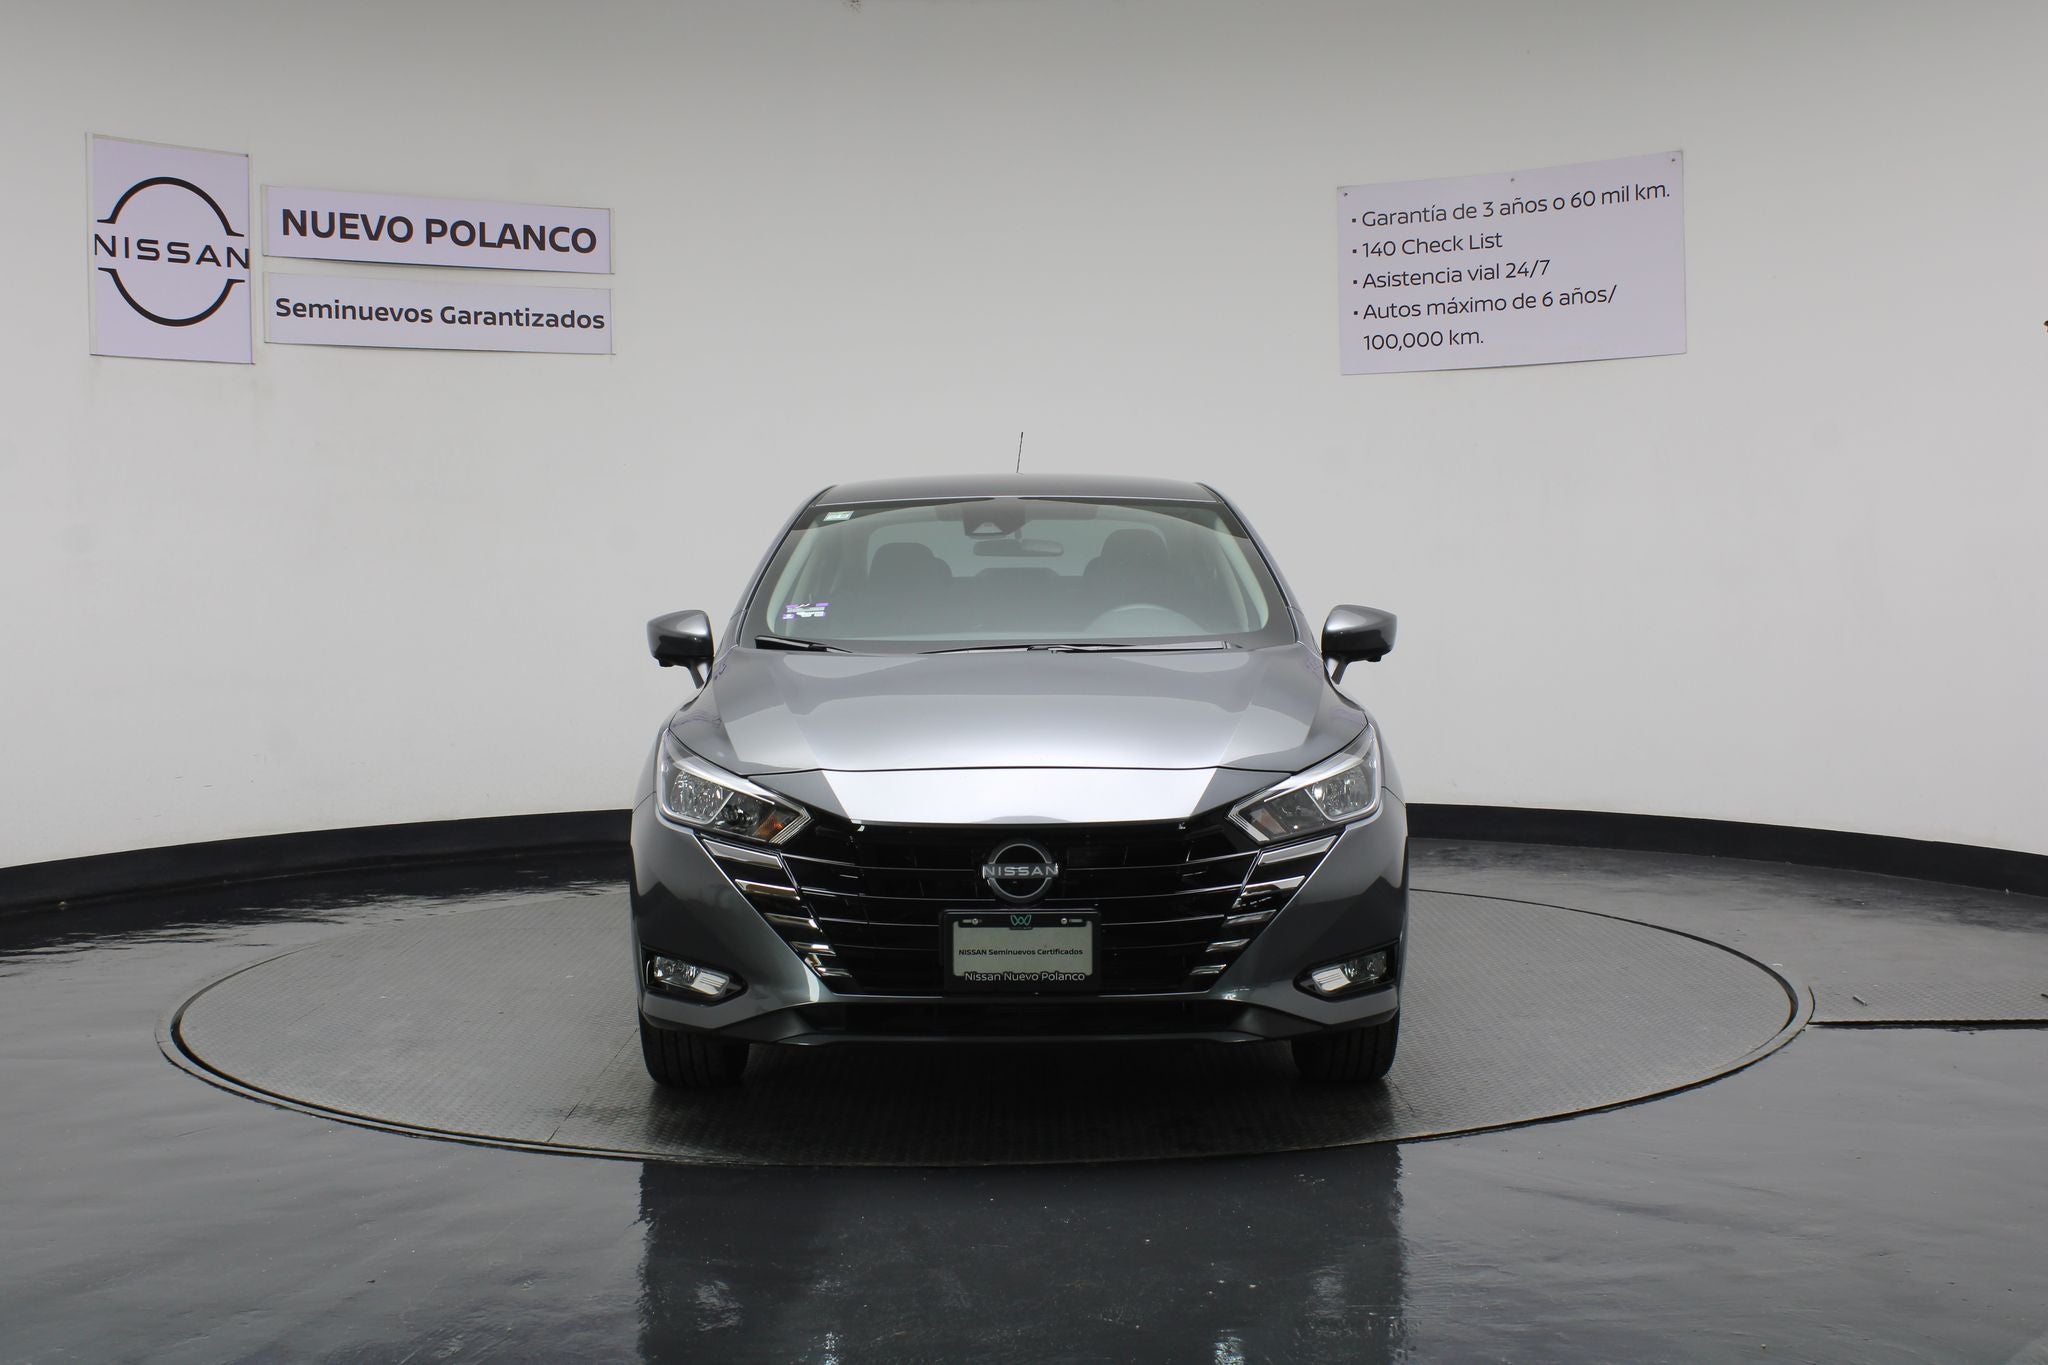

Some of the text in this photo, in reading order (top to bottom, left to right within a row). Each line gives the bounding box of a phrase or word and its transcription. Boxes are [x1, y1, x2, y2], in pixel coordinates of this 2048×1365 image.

[1362, 183, 1671, 227] Garantía de 3 años o 60 mil km.
[282, 208, 598, 254] NUEVO POLANCO
[1362, 232, 1504, 258] 140 Check List
[95, 232, 250, 269] NISSAN
[1362, 259, 1552, 289] Asistencia vial 24/7
[275, 297, 605, 330] Seminuevos Garantizados
[1363, 284, 1618, 320] Autos máximo de 6 años/
[1363, 329, 1485, 352] 100,000 km.
[983, 865, 1059, 877] NISSAN
[958, 947, 1084, 956] NISSAN Seminuevos Certificados
[964, 971, 1086, 982] Nissan Nuevo Polanco
